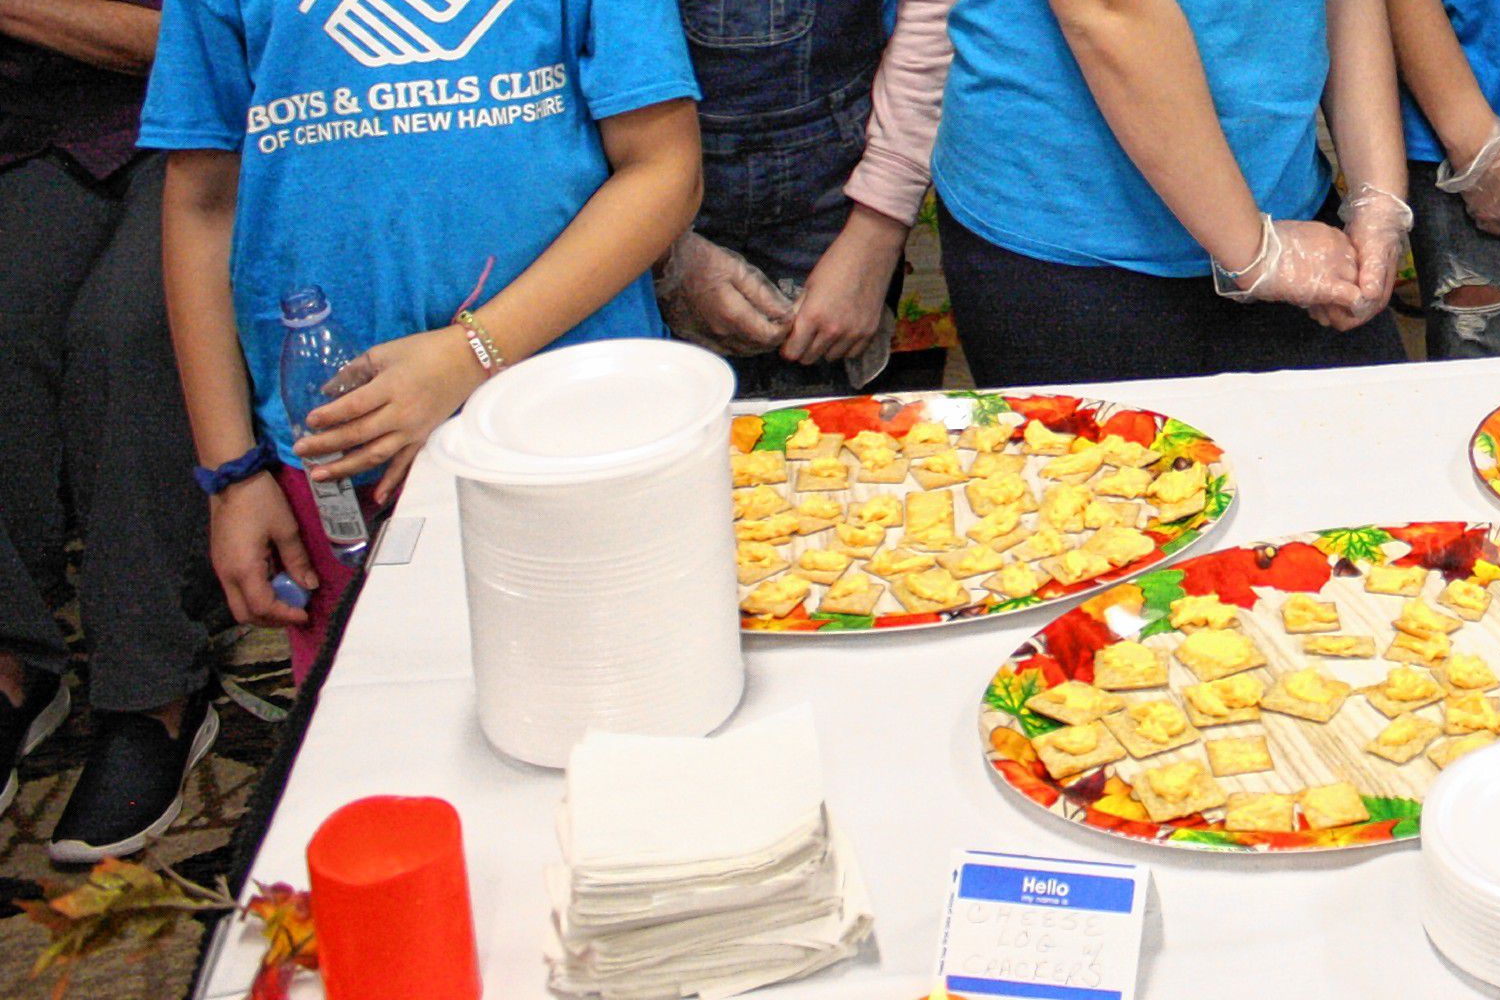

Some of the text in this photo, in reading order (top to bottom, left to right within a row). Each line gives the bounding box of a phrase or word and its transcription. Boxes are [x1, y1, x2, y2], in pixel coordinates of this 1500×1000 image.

[247, 91, 328, 134] BOYS
[333, 87, 362, 116] &
[368, 76, 481, 111] GIRLS
[258, 129, 291, 154] OF
[294, 116, 388, 146] CENTRAL
[392, 110, 452, 135] NEW
[1022, 875, 1070, 897] Hello
[965, 903, 1105, 937] CHEESE
[962, 953, 1102, 988] CRACKERS
